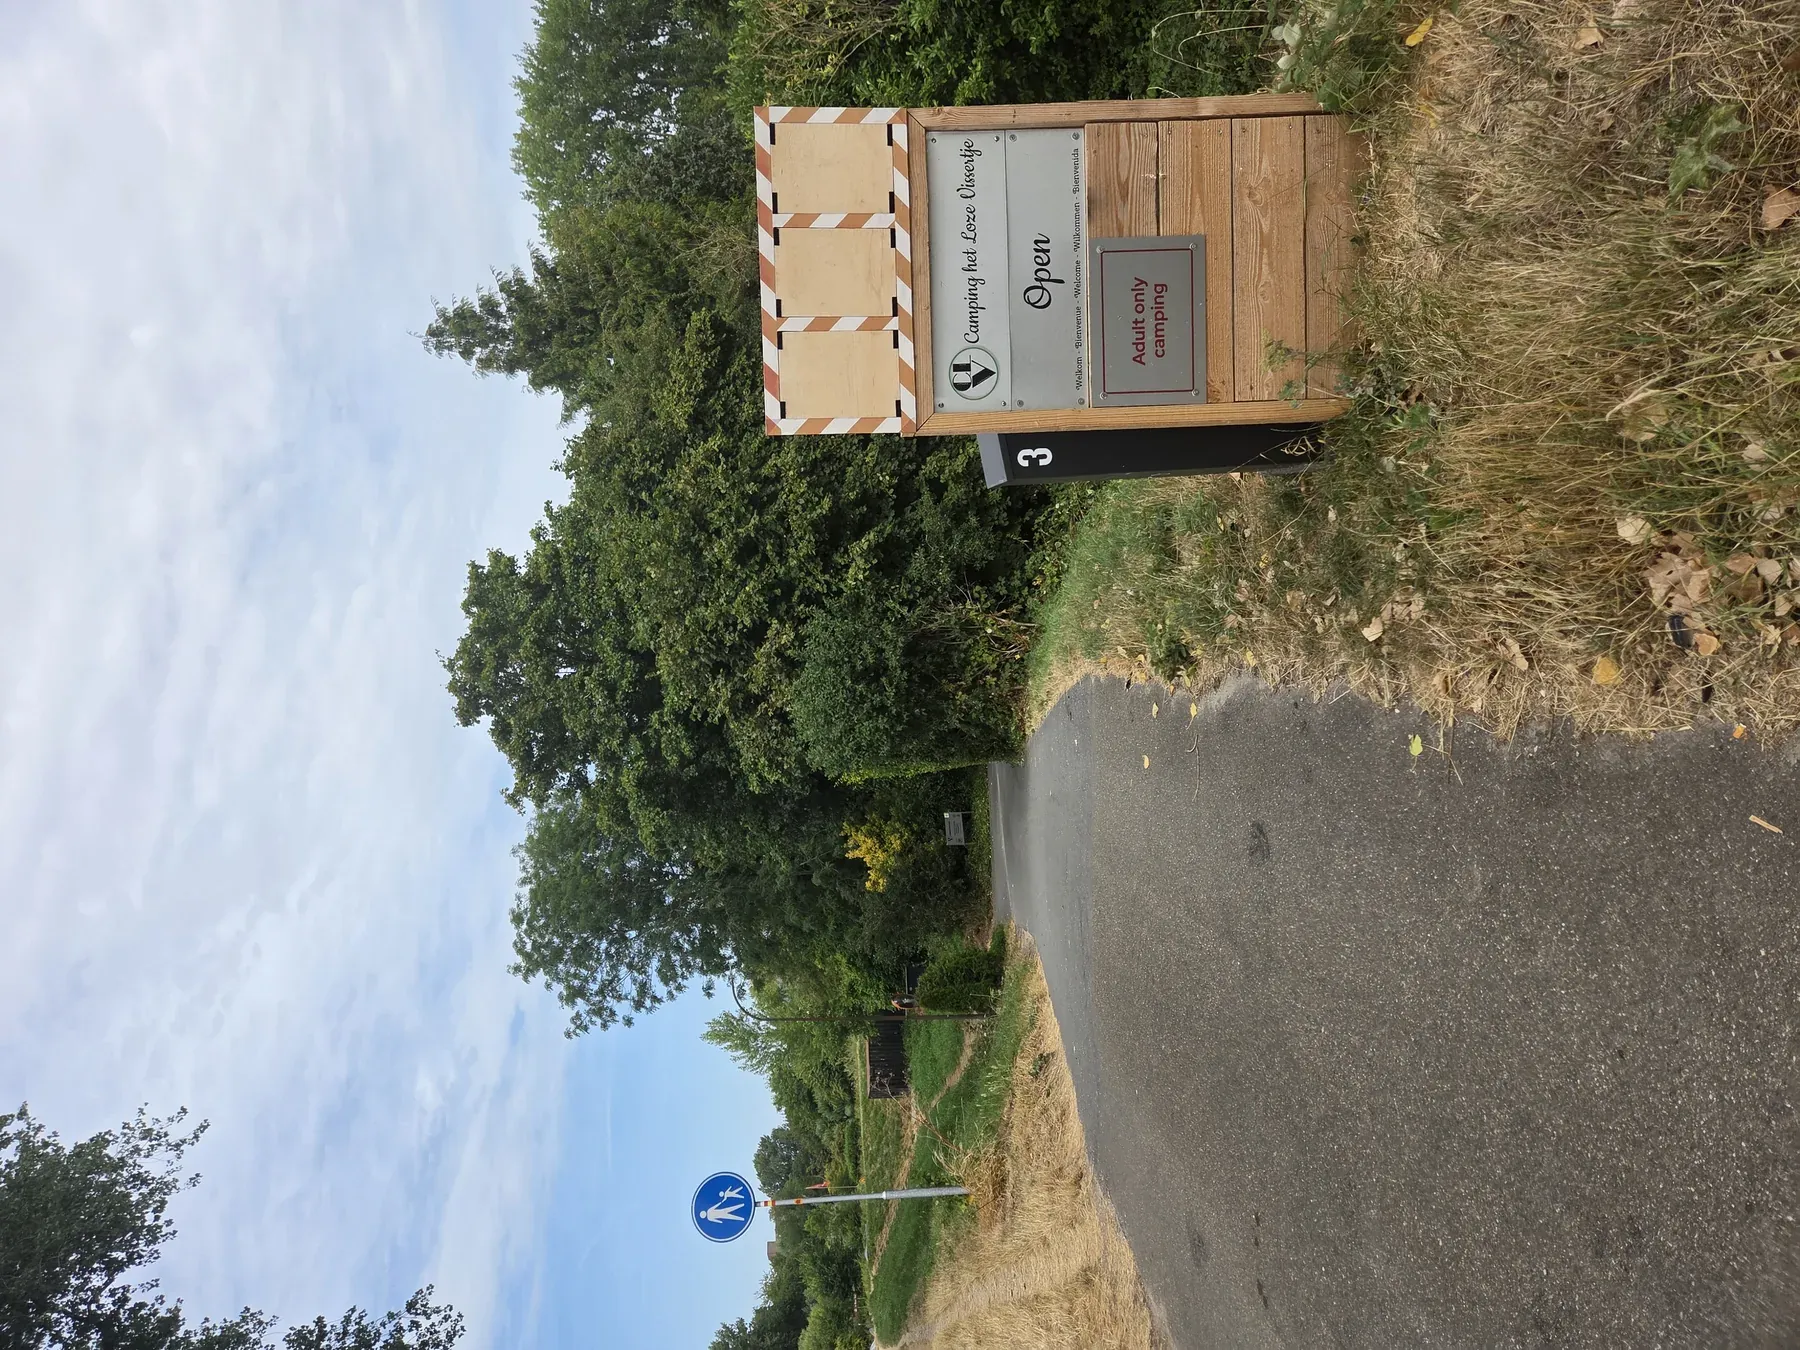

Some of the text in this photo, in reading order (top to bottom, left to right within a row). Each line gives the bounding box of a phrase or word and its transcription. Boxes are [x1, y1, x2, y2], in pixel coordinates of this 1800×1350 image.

[1071, 148, 1080, 195] Bienvenida
[956, 137, 986, 344] Camping het Loze Vissertje
[1073, 202, 1081, 252] Wilkommen
[1023, 232, 1066, 310] Open
[1073, 259, 1082, 299] Welcome
[1073, 306, 1082, 349] Bienvenue
[1131, 276, 1148, 366] Adult only
[1150, 283, 1168, 358] camping
[1075, 356, 1083, 391] Welkom
[1017, 447, 1053, 467] 3
